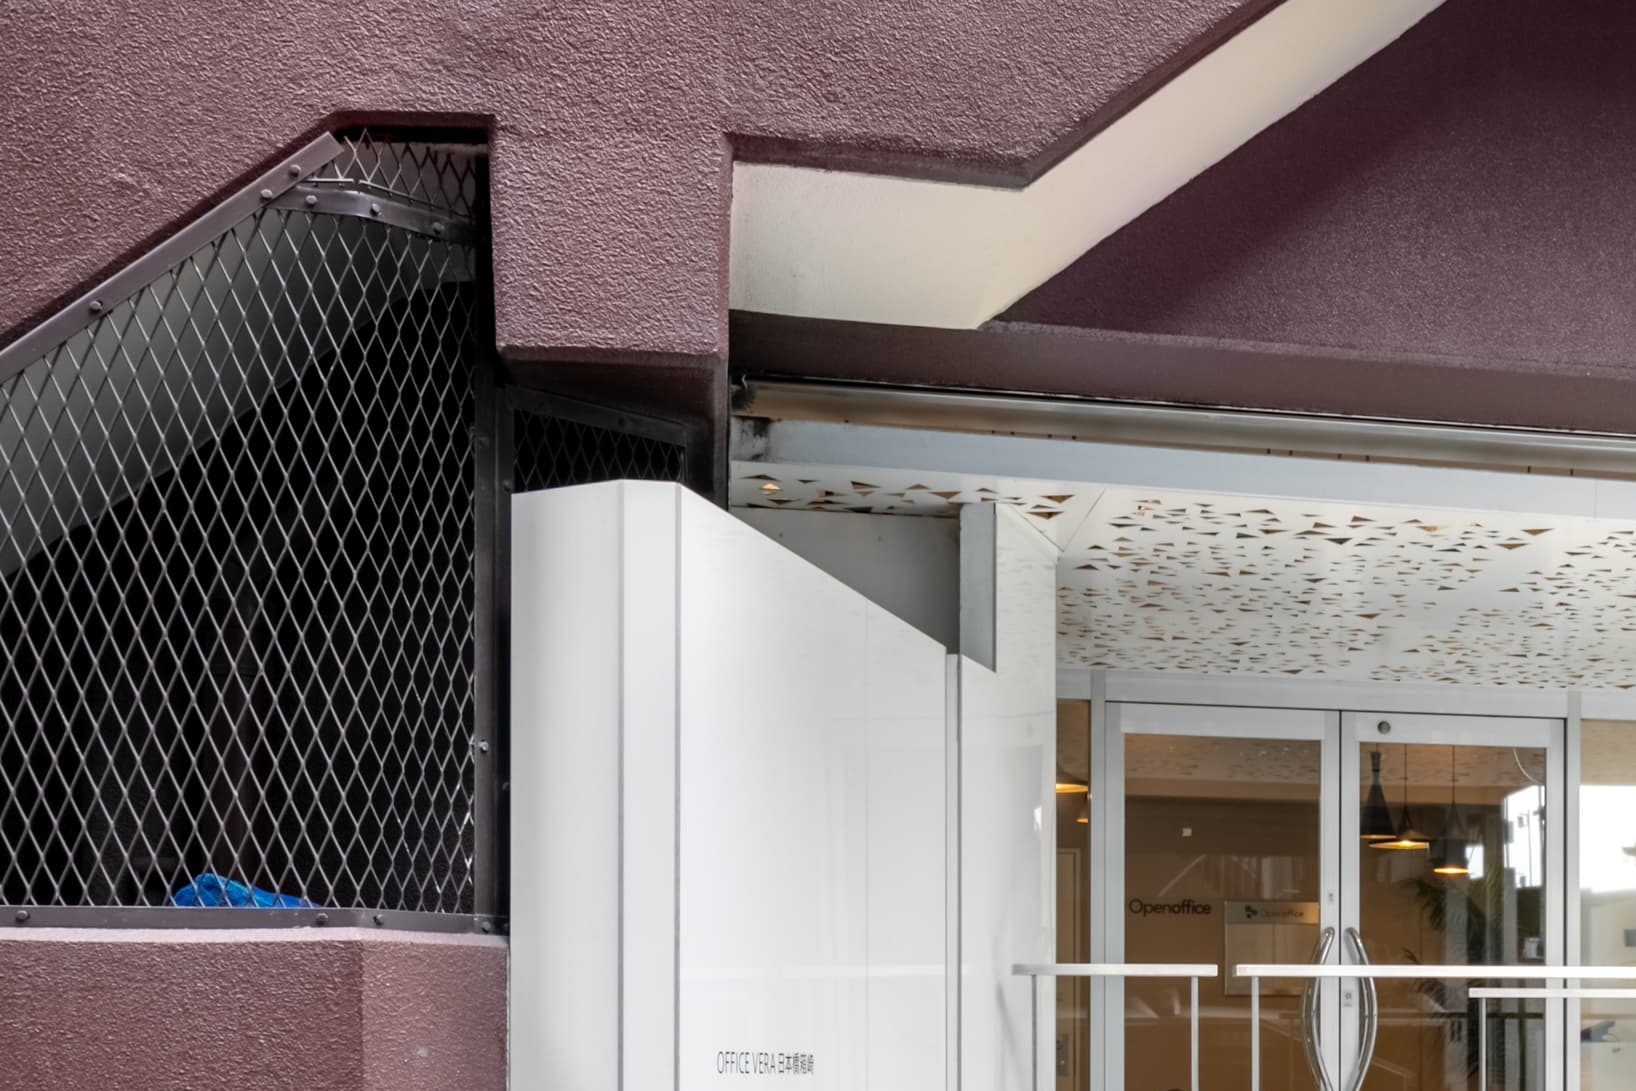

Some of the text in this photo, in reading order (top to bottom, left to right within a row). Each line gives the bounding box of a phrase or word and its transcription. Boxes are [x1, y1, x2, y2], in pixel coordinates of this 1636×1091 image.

[1129, 898, 1211, 916] Openoffice
[717, 1051, 750, 1074] OFFICE
[752, 1052, 776, 1074] VERA
